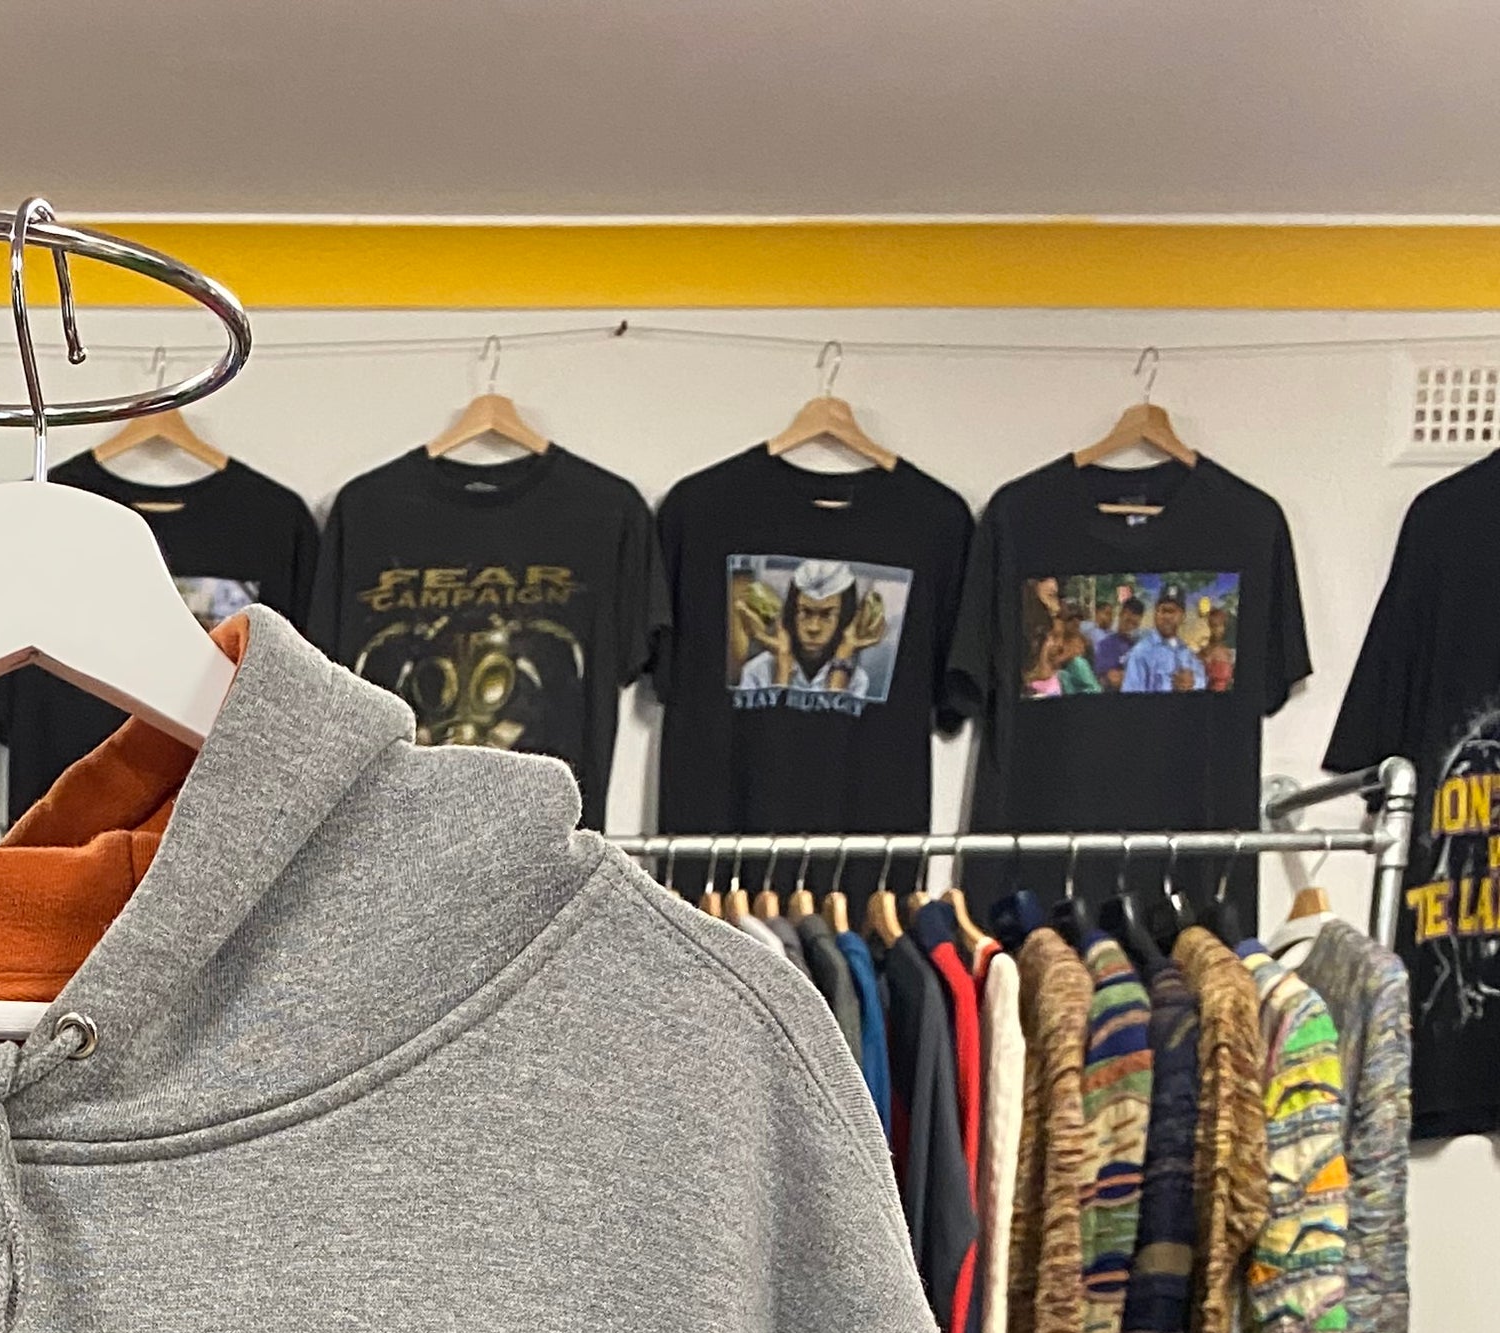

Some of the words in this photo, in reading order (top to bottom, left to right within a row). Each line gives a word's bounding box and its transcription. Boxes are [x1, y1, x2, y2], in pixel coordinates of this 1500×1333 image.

[378, 565, 573, 589] FEAR
[370, 586, 575, 612] CAMPAIGN
[1457, 876, 1500, 935] LA
